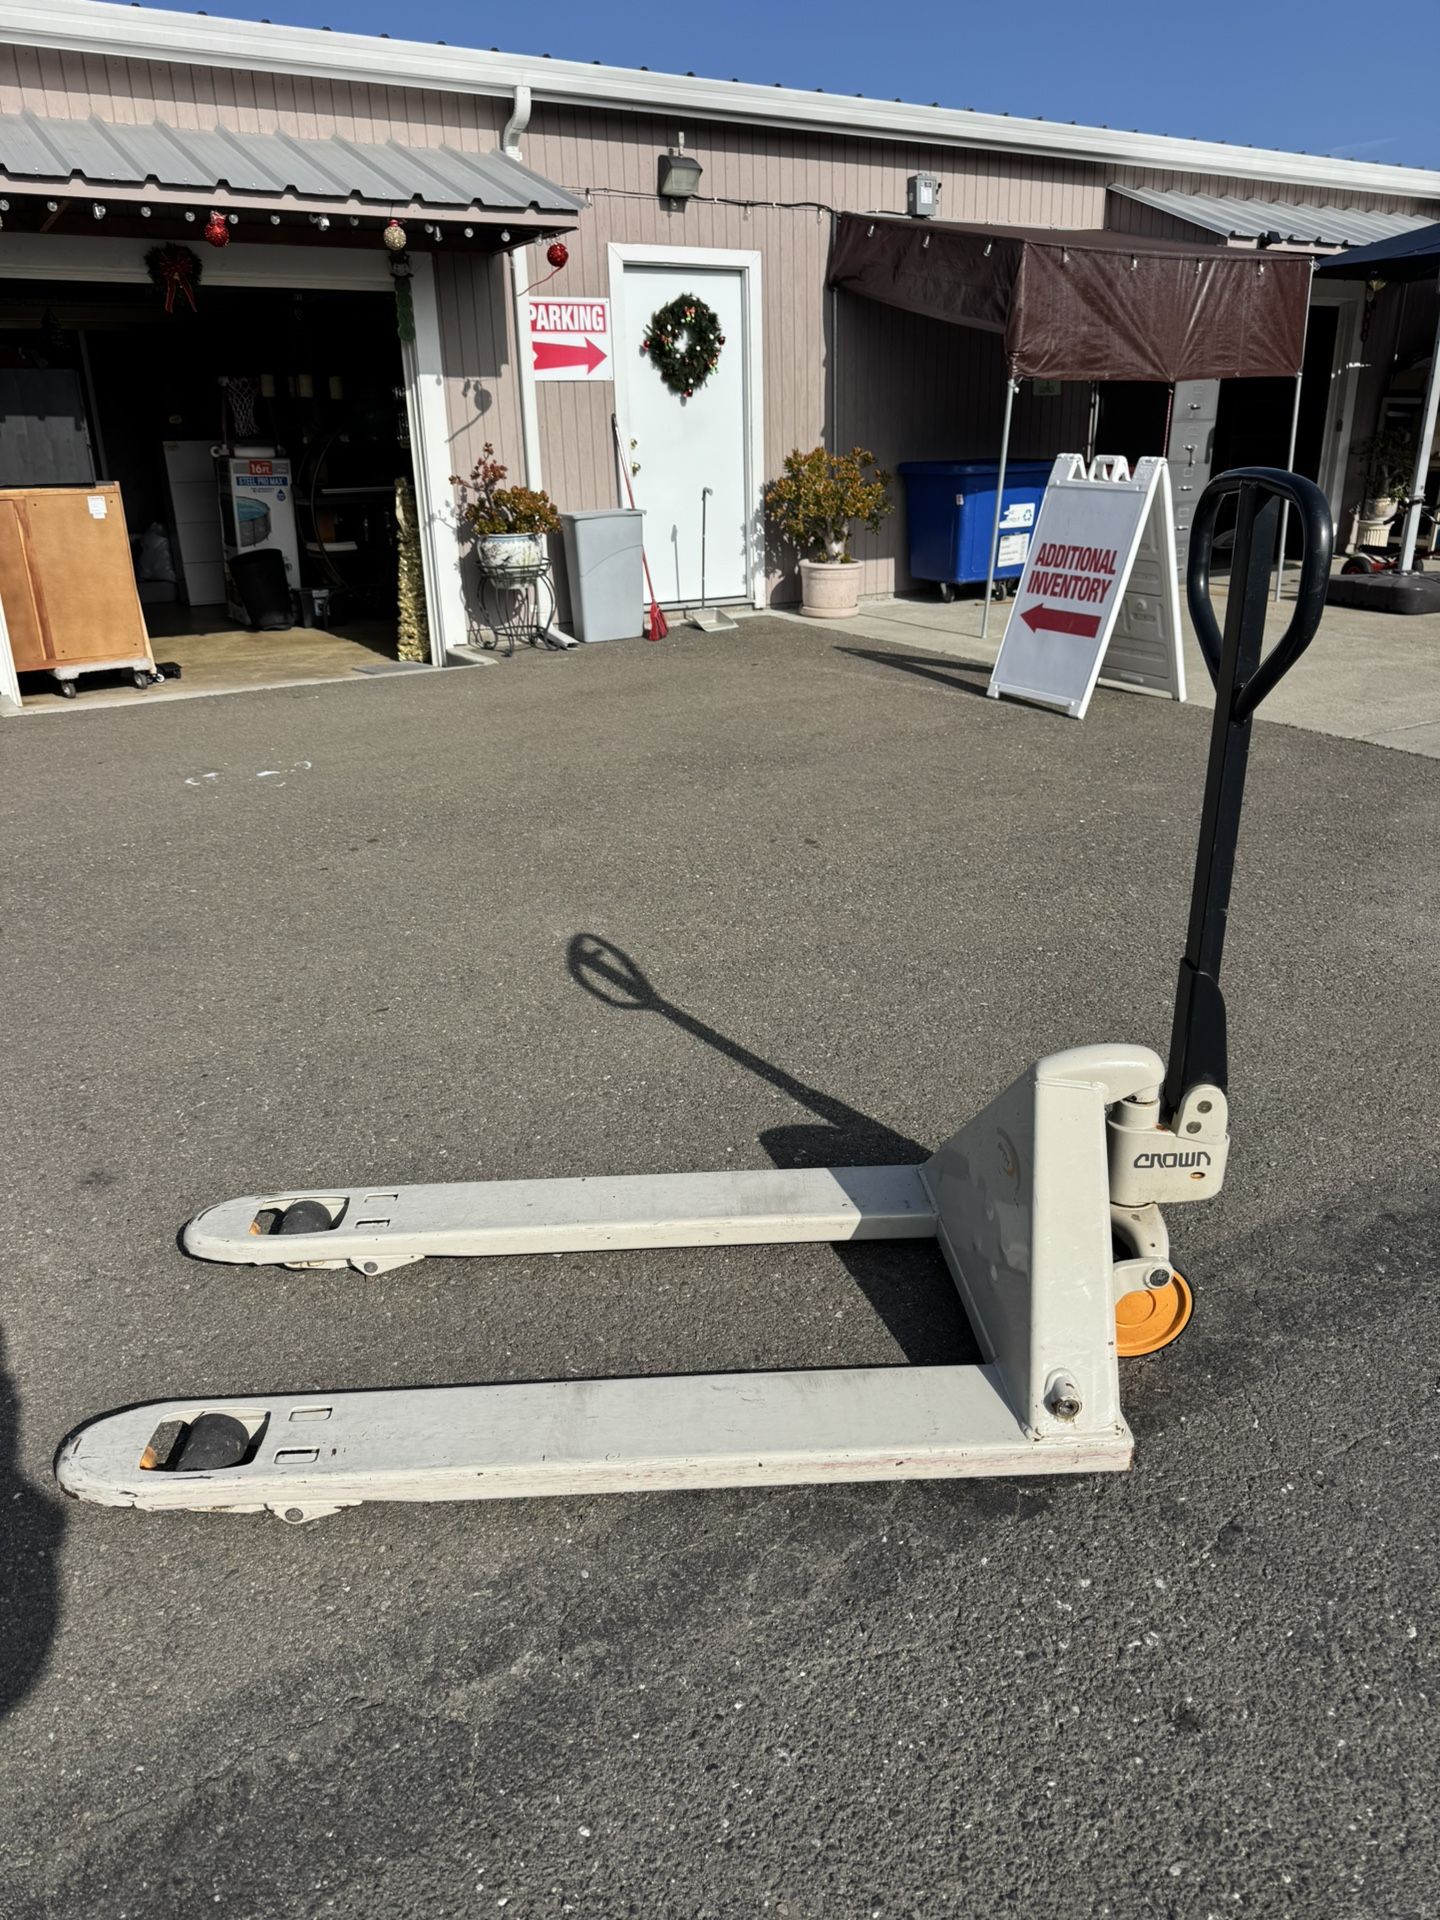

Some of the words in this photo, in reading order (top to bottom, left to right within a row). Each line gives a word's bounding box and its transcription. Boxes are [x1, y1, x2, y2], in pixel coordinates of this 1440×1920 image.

[529, 304, 605, 331] PARKING
[1034, 542, 1118, 575] ADDITIONAL
[1026, 570, 1113, 604] INVENTORY
[1133, 1151, 1212, 1169] CROWN
